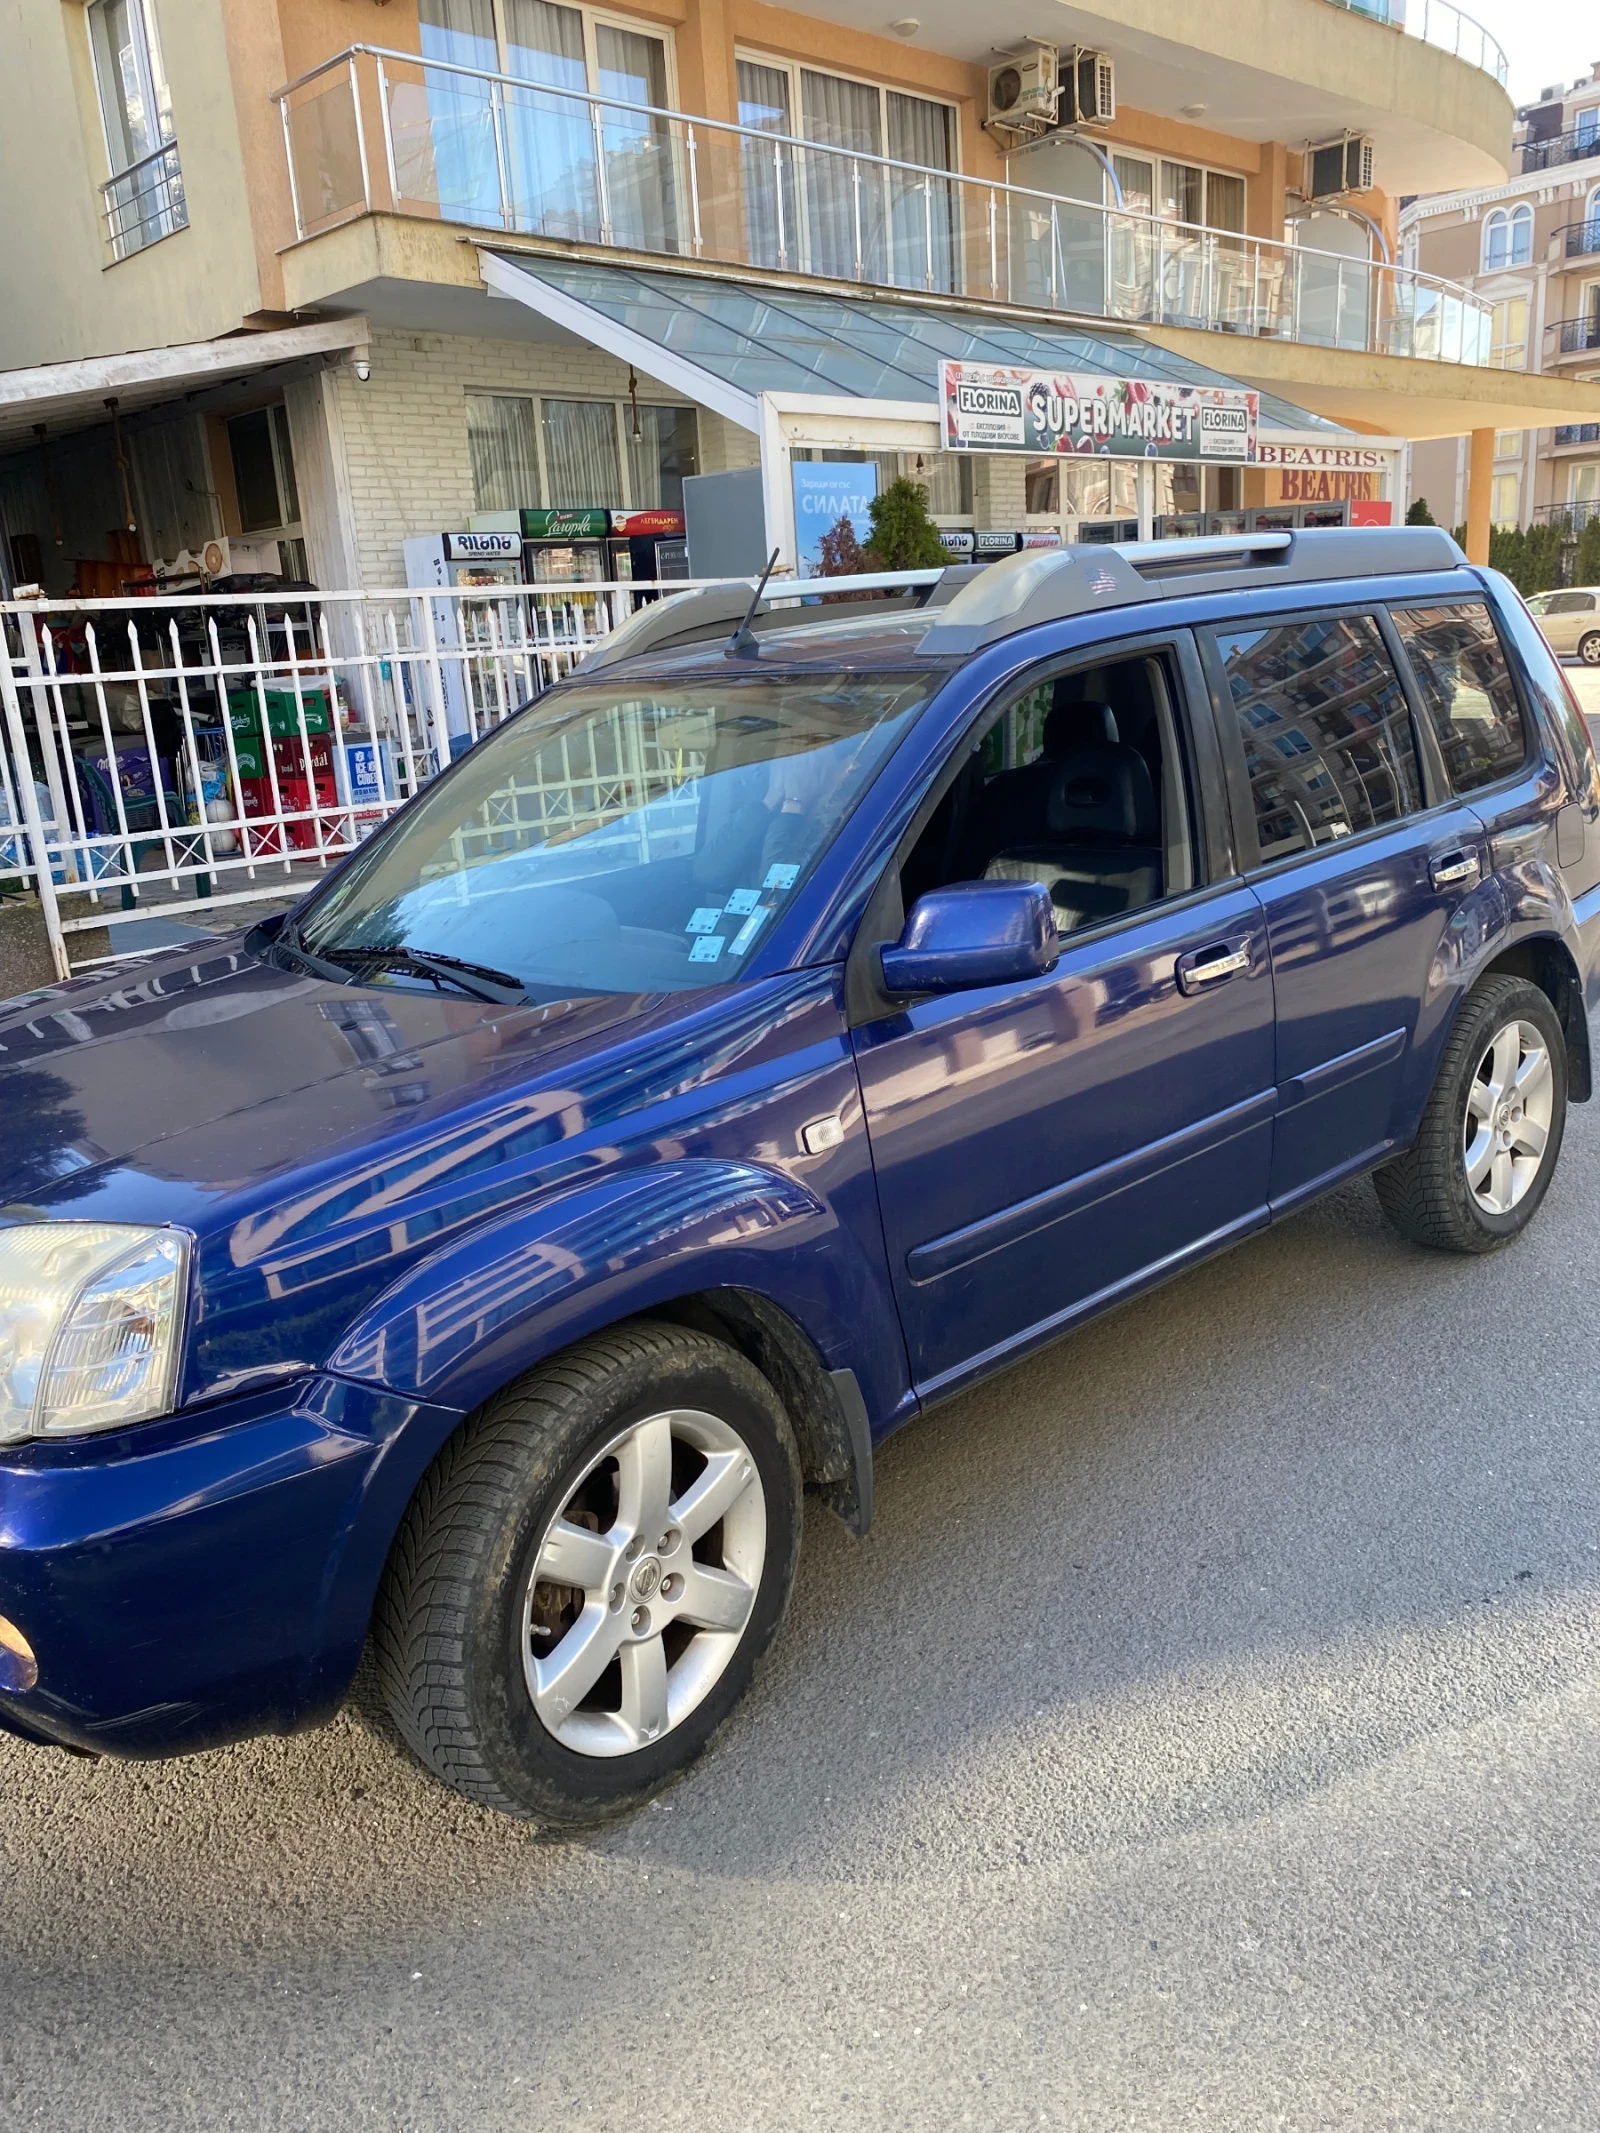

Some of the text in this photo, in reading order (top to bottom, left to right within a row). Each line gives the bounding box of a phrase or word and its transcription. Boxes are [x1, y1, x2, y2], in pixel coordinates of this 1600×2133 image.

[961, 389, 1020, 414] FLORINA
[1032, 394, 1196, 442] SUPERMARKET
[1203, 409, 1246, 431] FLORINA
[1257, 445, 1378, 468] BEATRIS
[801, 479, 828, 490] Зареди
[829, 481, 838, 489] се
[1280, 469, 1372, 501] BEATRIS
[802, 495, 869, 514] СИЛАТА
[640, 517, 679, 525] ЛЕГЕНДАРЕН
[979, 534, 1014, 548] FLORINA
[355, 762, 367, 774] ICE
